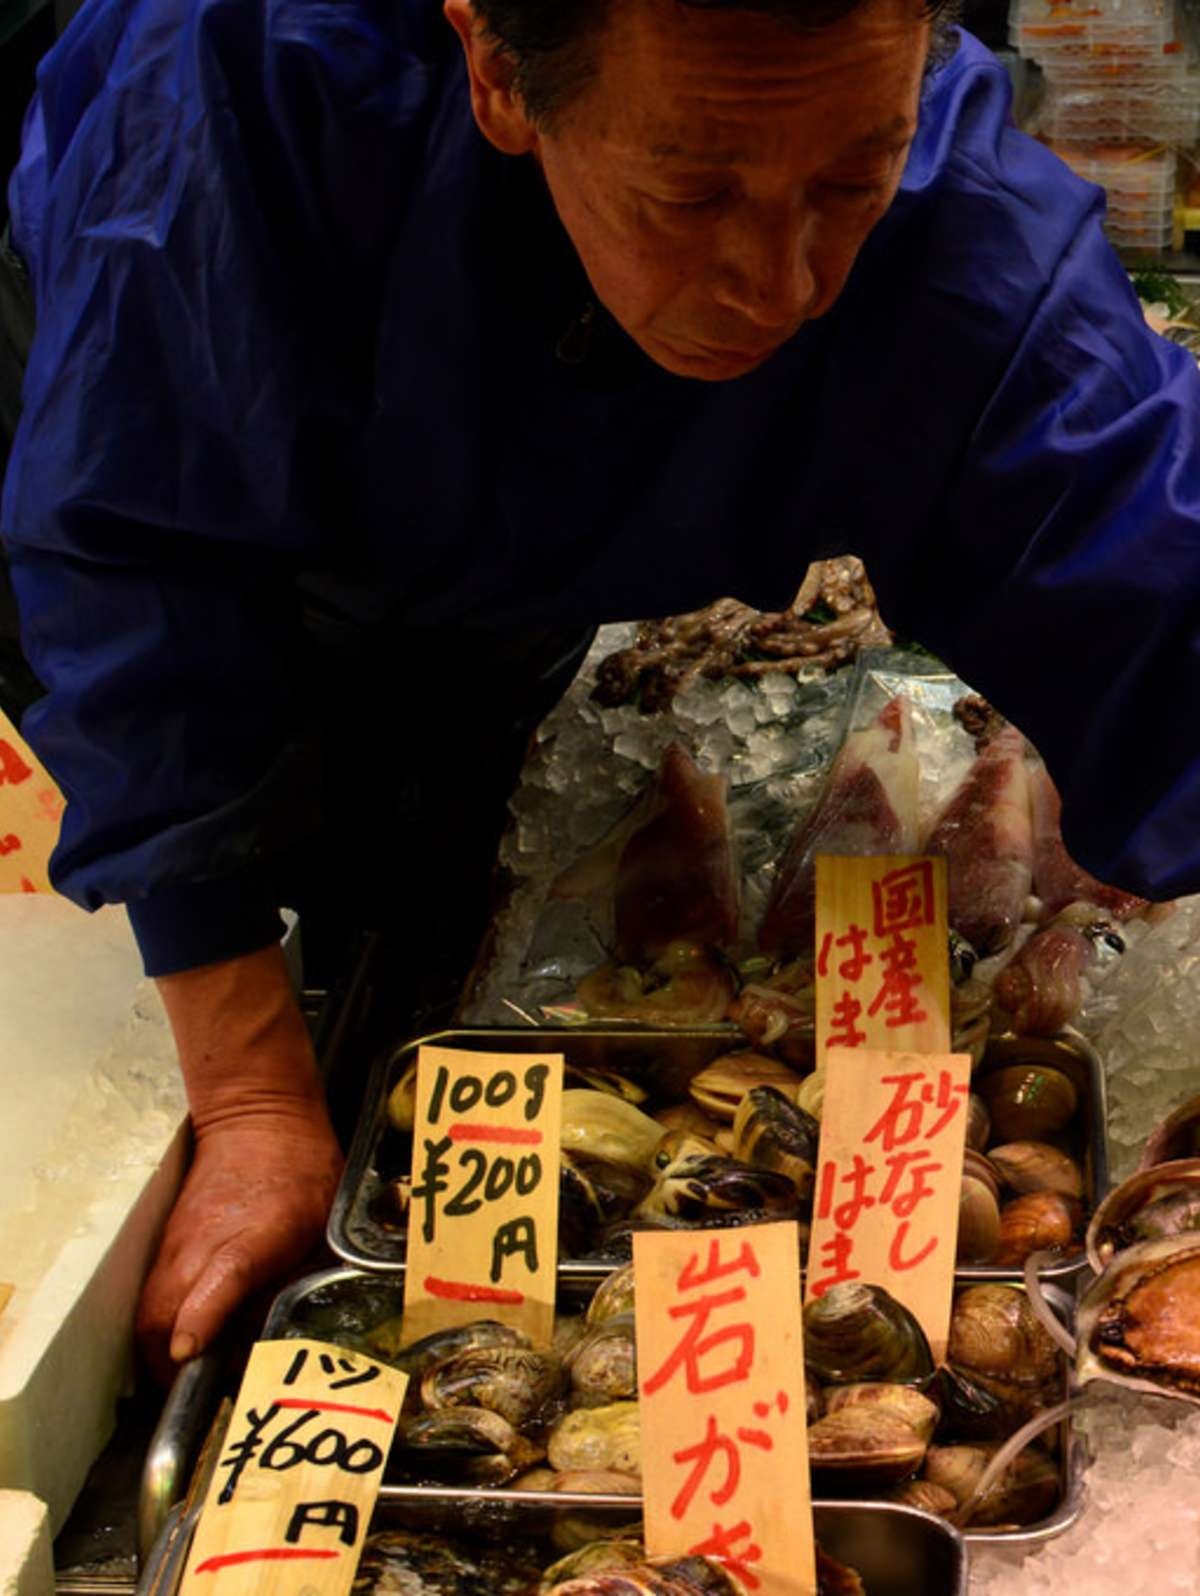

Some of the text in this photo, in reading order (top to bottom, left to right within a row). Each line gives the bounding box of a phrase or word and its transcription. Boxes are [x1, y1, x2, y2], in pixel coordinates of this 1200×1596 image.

[426, 1064, 550, 1125] 100g
[410, 1136, 542, 1243] ¥200
[862, 1068, 970, 1273] 砂なし
[489, 1216, 538, 1284] 円
[217, 1402, 384, 1506] ¥600
[284, 1500, 359, 1547] 円
